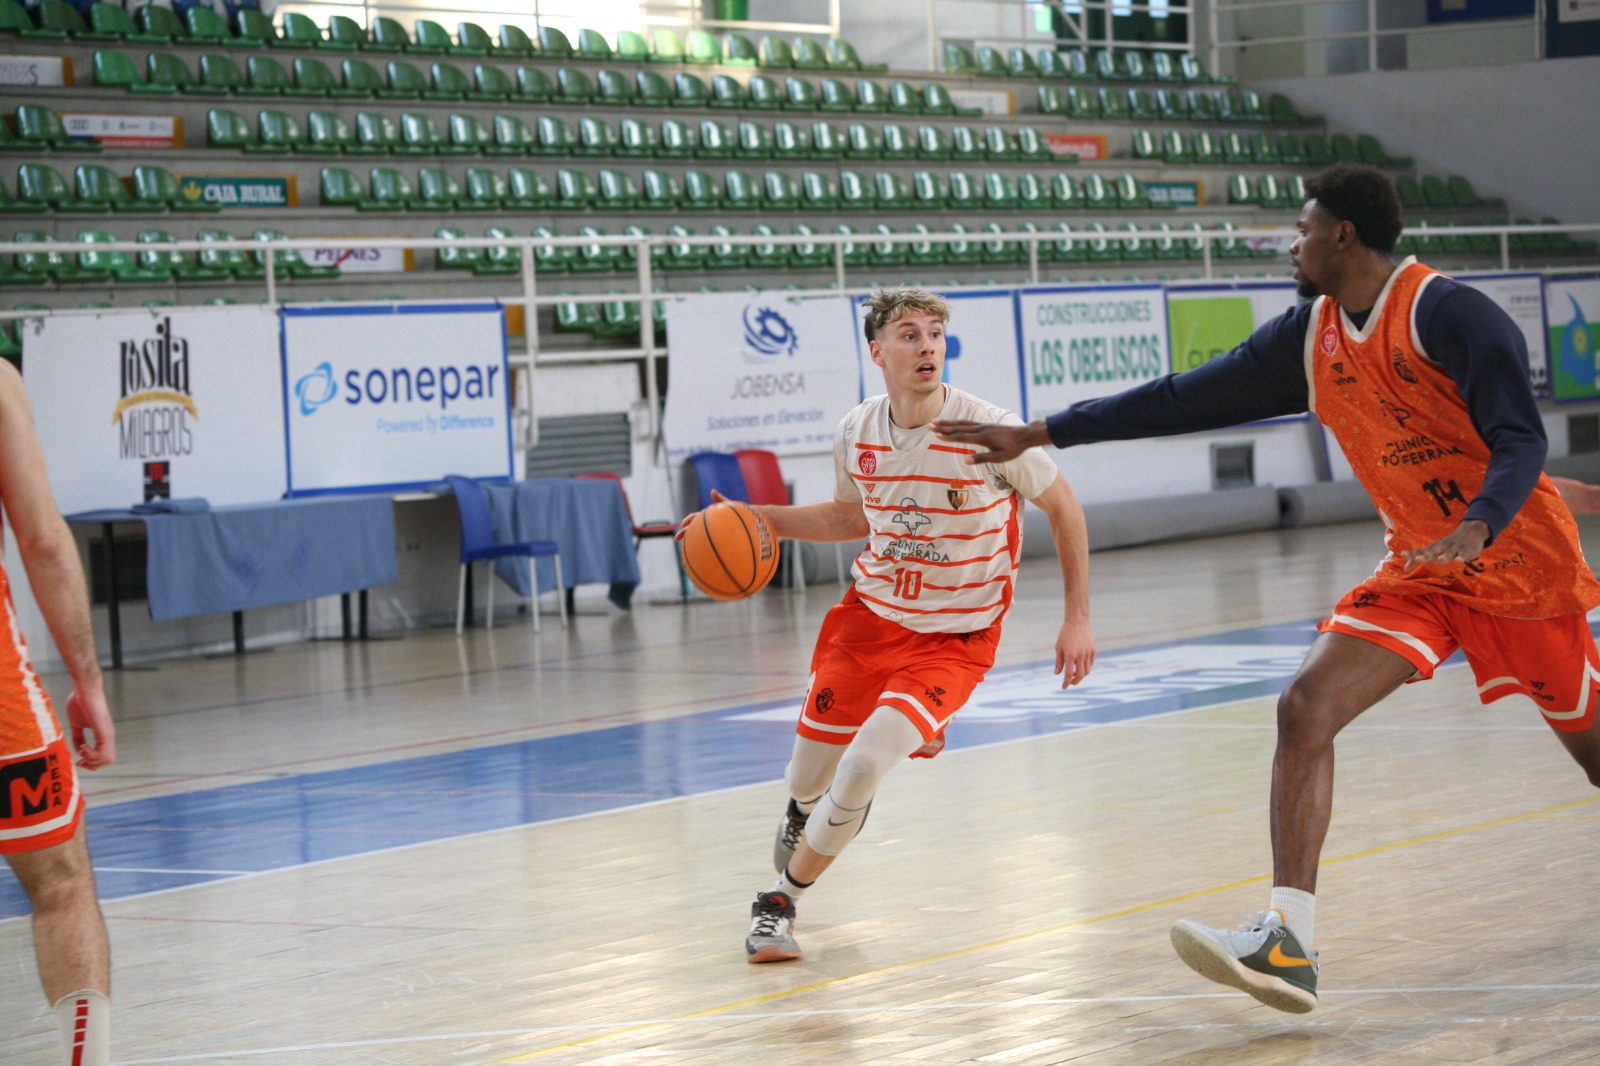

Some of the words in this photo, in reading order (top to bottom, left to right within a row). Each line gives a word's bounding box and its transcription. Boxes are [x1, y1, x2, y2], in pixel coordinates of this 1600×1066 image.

[204, 184, 238, 202] CAJA
[240, 185, 284, 202] RURAL
[1037, 301, 1151, 326] CONSTRUCCIONES
[120, 316, 191, 398] rosita
[1031, 339, 1064, 385] LOS
[1069, 334, 1161, 383] OBELISCOS
[345, 364, 498, 410] sonepar
[731, 372, 806, 400] JOBENSA
[1333, 376, 1357, 386] vive
[376, 418, 423, 434] Powered
[440, 414, 495, 431] Difference
[1422, 478, 1470, 517] 14
[1493, 552, 1526, 571] rest
[893, 567, 922, 600] 10
[924, 689, 943, 708] vive
